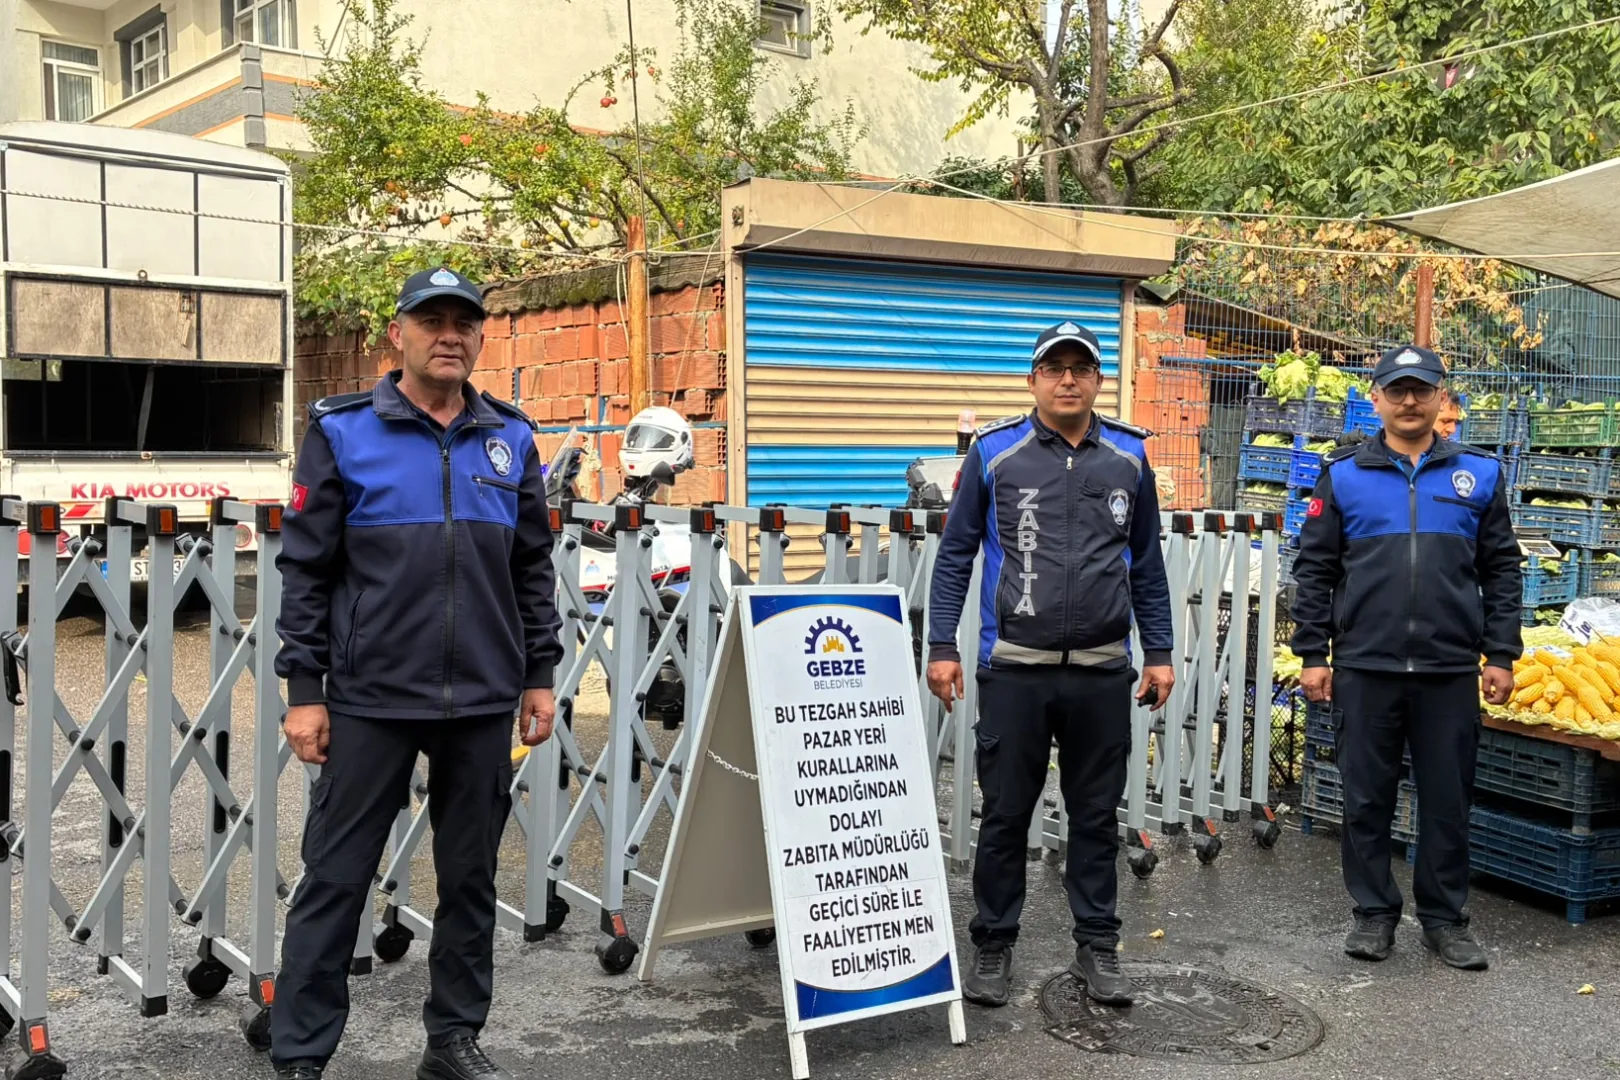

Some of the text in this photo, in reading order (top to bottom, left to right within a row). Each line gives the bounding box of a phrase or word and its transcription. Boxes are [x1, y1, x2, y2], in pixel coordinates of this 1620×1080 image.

[71, 481, 231, 499] KIA MOTORS
[1013, 488, 1040, 617] ZABITA
[806, 658, 866, 678] GEBZE
[813, 677, 863, 690] BELEDİYESİ
[775, 695, 905, 724] BU TEZGAH SAHİBİ
[803, 723, 887, 750] PAZAR YERİ
[797, 752, 899, 779] KURALLARINA
[794, 778, 908, 807] UYMADIĞINDAN
[829, 808, 883, 832] DOLAYI
[783, 827, 930, 867] ZABITA MÜDÜRLÜĞÜ
[815, 861, 909, 892] TARAFINDAN
[809, 887, 924, 924] GEÇİCİ SÜRE İLE
[803, 914, 935, 953] FAALİYETTEN MEN
[831, 944, 917, 978] EDİLMİŞTİR.
